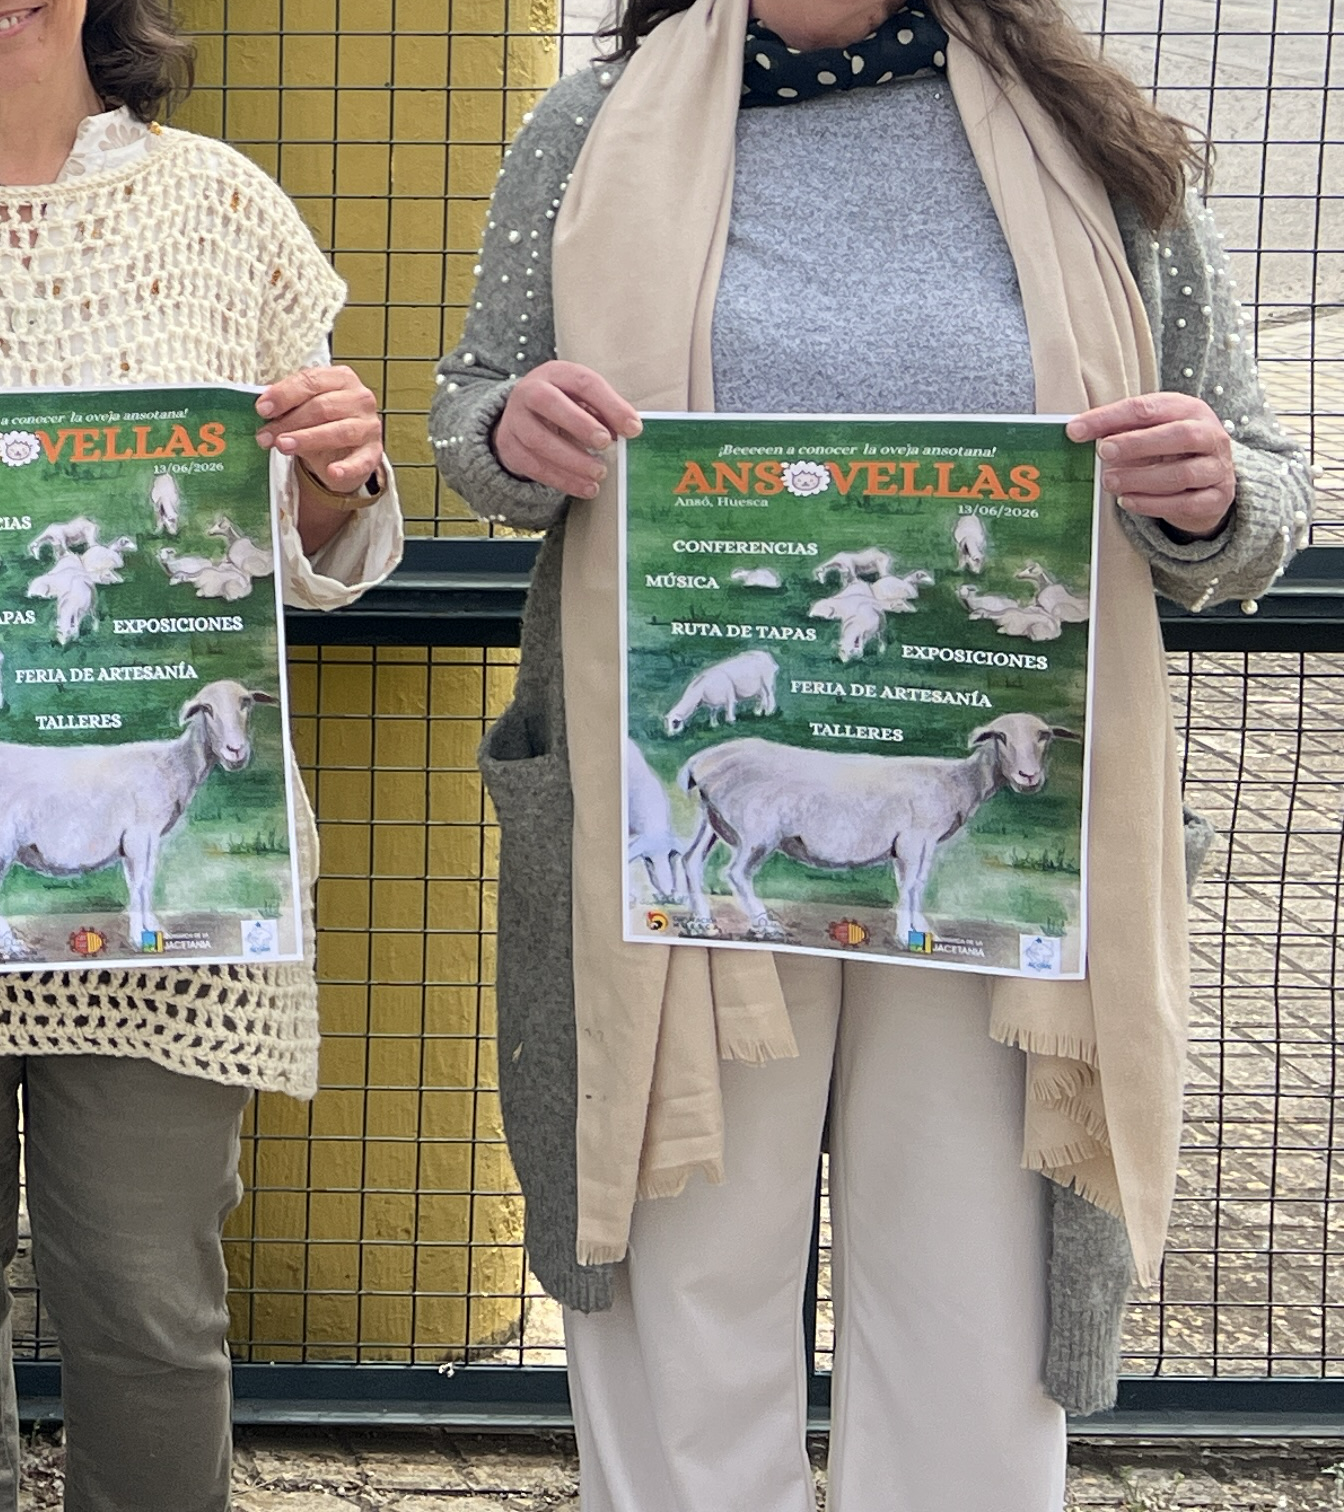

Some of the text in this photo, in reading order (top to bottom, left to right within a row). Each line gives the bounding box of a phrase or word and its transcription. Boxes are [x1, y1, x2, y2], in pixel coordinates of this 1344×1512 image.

[0, 418, 8, 426] a
[11, 415, 64, 425] conocer
[70, 411, 82, 422] la
[85, 411, 120, 423] oveja
[123, 408, 189, 421] ansotana!
[786, 447, 795, 455] a
[798, 446, 857, 455] conocer
[863, 443, 876, 455] la
[880, 444, 919, 457] oveja
[922, 446, 997, 457] ansotana!
[154, 461, 224, 475] 13/06/2026
[717, 497, 768, 507] Huesca
[959, 504, 1039, 518] 13/06/2026
[672, 540, 818, 555] CONFERENCIAS
[645, 572, 720, 589] MÚSICA
[112, 616, 244, 634] EXPOSICIONES
[671, 622, 817, 641] RUTA DE TAPAS
[901, 645, 1048, 670] EXPOSICIONES
[15, 661, 199, 683] FERIA DE ARTESANÍA
[791, 680, 992, 708] FERIA DE ARTESANÍA
[35, 713, 122, 730] TALLERES
[809, 722, 904, 742] TALLERES
